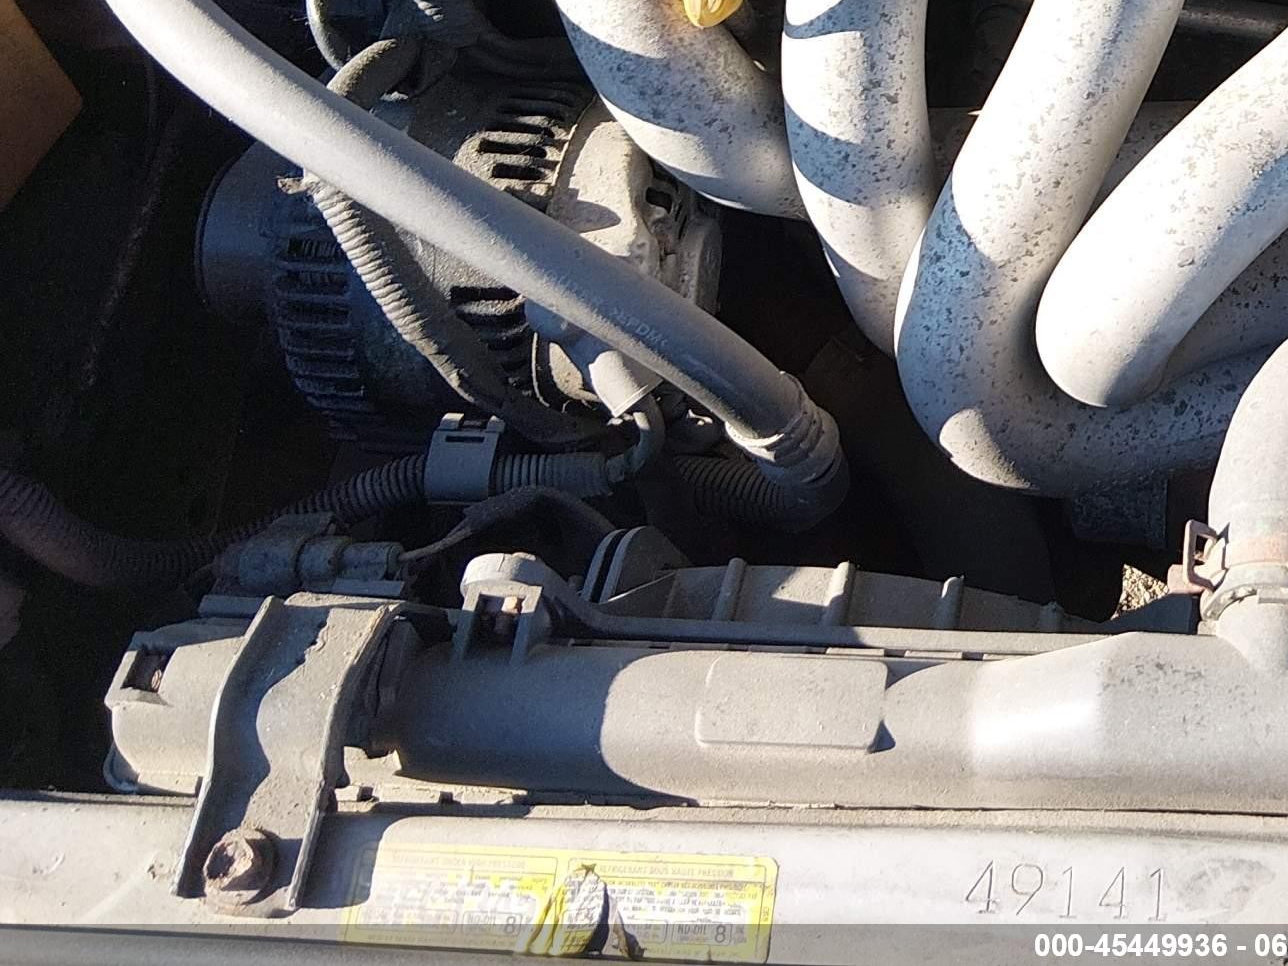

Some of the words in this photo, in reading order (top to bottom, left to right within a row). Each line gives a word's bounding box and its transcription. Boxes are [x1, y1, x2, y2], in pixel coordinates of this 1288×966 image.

[965, 859, 1166, 921] 49141
[503, 916, 516, 935] 8
[715, 924, 727, 944] 8
